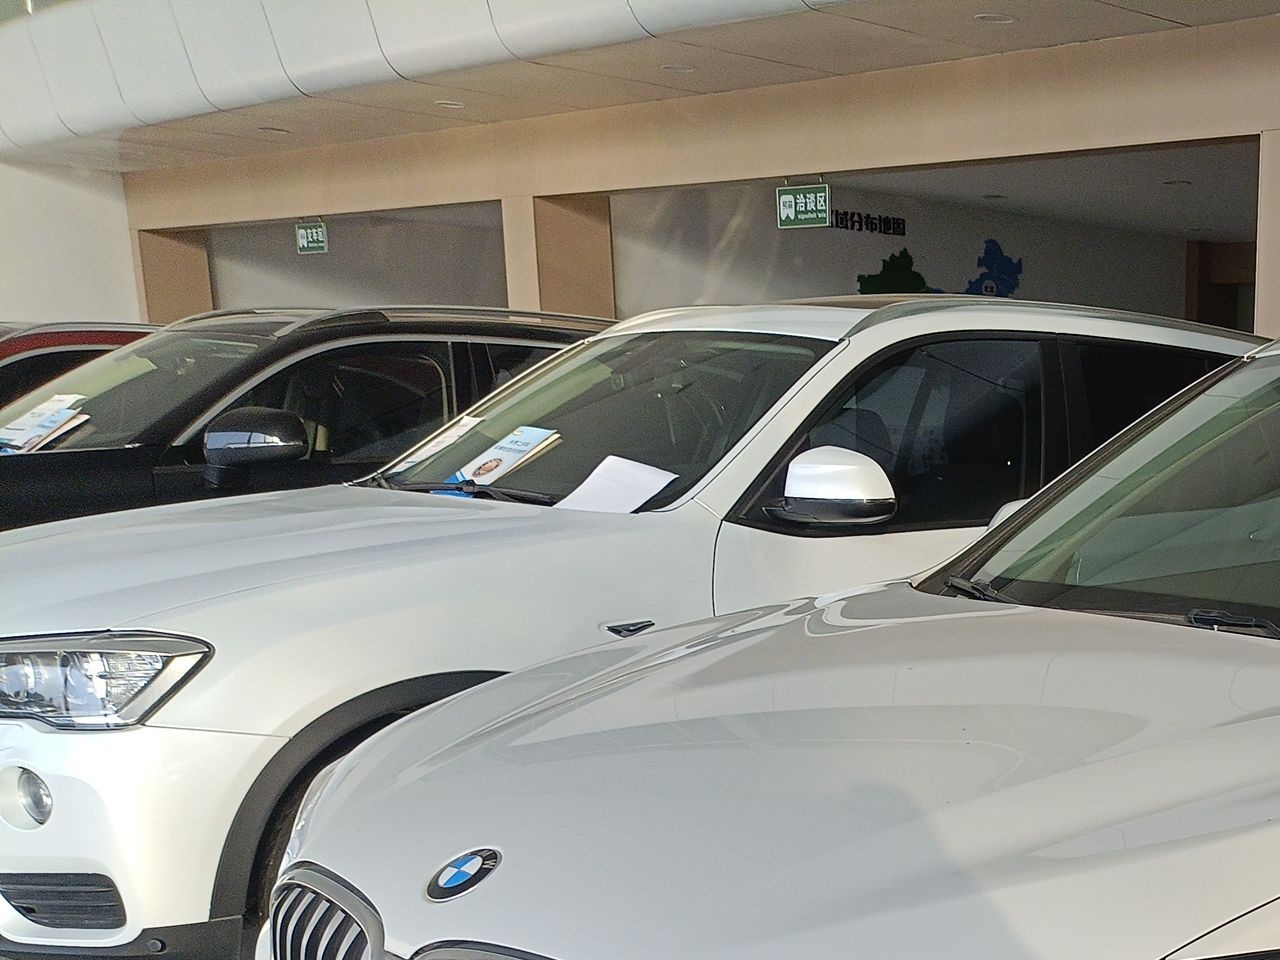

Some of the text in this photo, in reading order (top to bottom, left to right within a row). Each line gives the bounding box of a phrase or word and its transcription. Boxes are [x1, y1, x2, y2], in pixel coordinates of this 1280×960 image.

[796, 193, 826, 212] 洽谈区
[832, 209, 906, 237] 域分布地图
